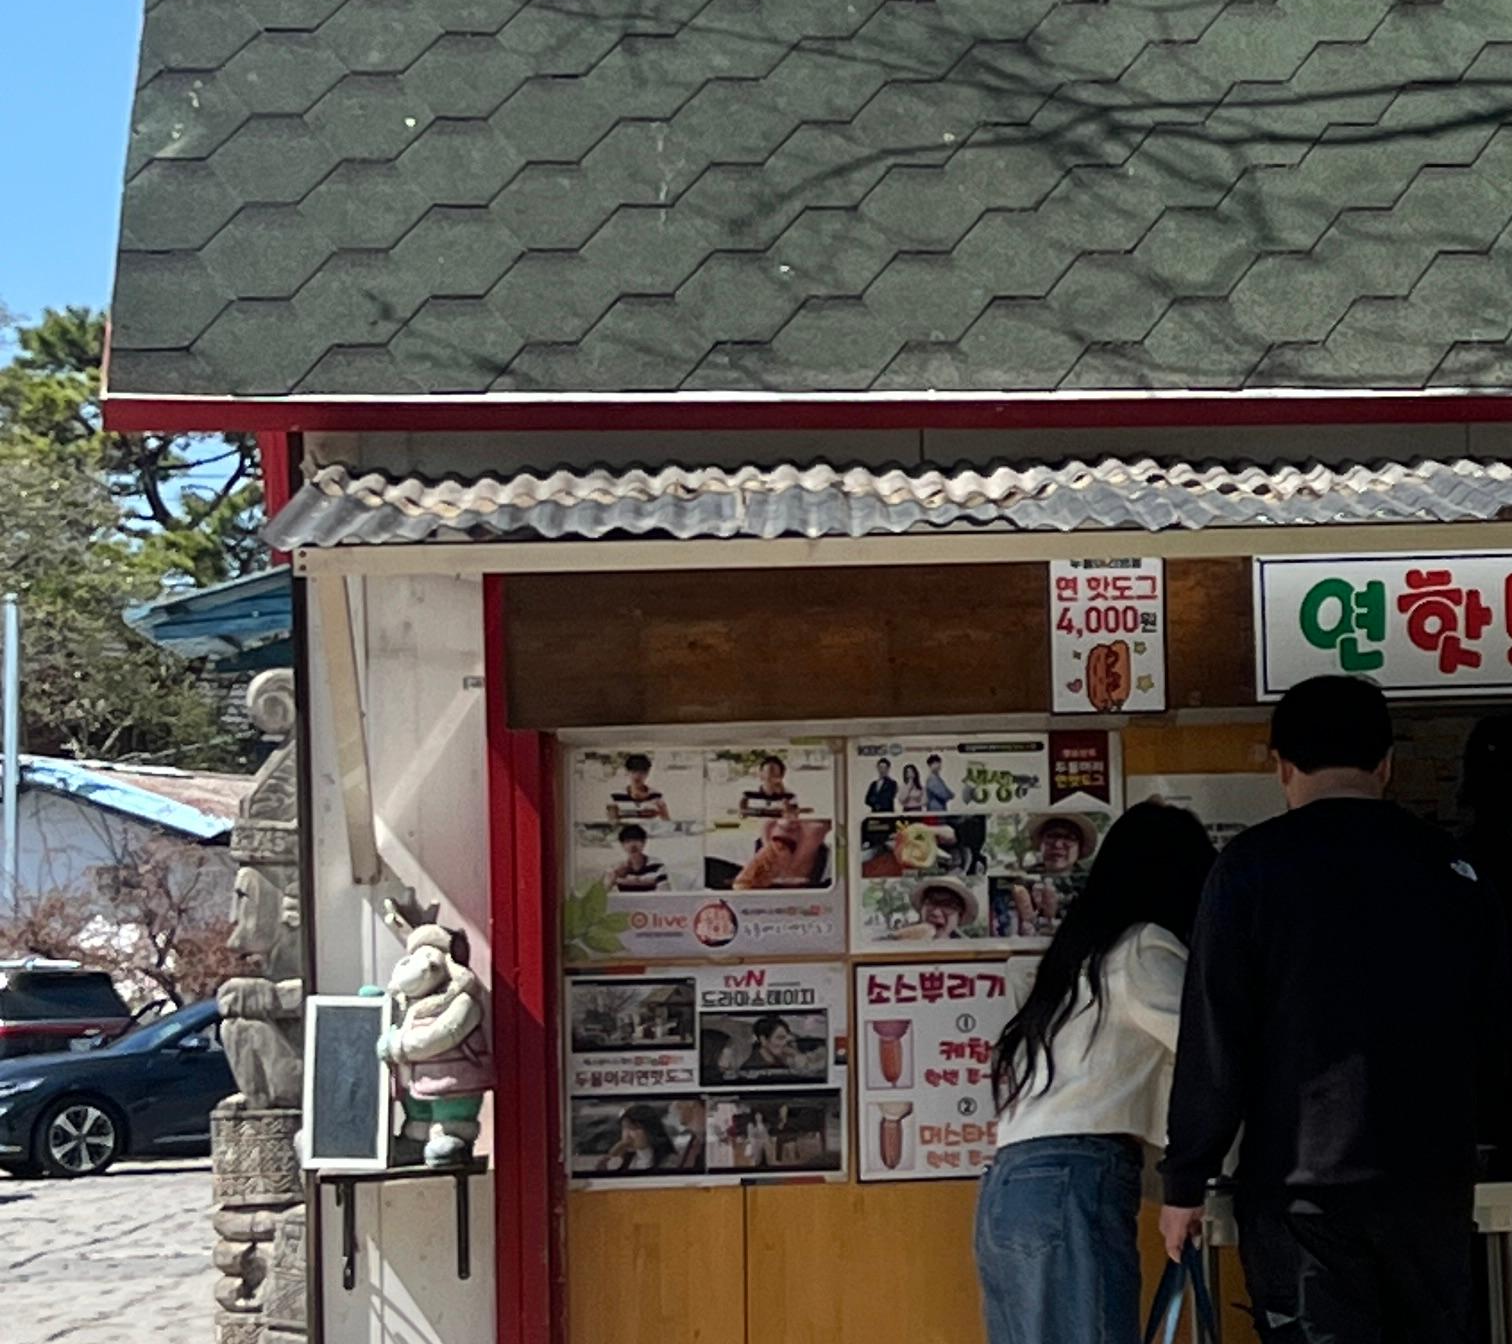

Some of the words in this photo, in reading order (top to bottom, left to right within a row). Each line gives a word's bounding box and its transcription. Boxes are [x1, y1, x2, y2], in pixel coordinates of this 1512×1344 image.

[1056, 576, 1078, 602] 연
[1056, 605, 1158, 638] 4,000원
[701, 988, 815, 1007] 드라마스테이지
[867, 971, 1006, 1005] 소스뿌리기
